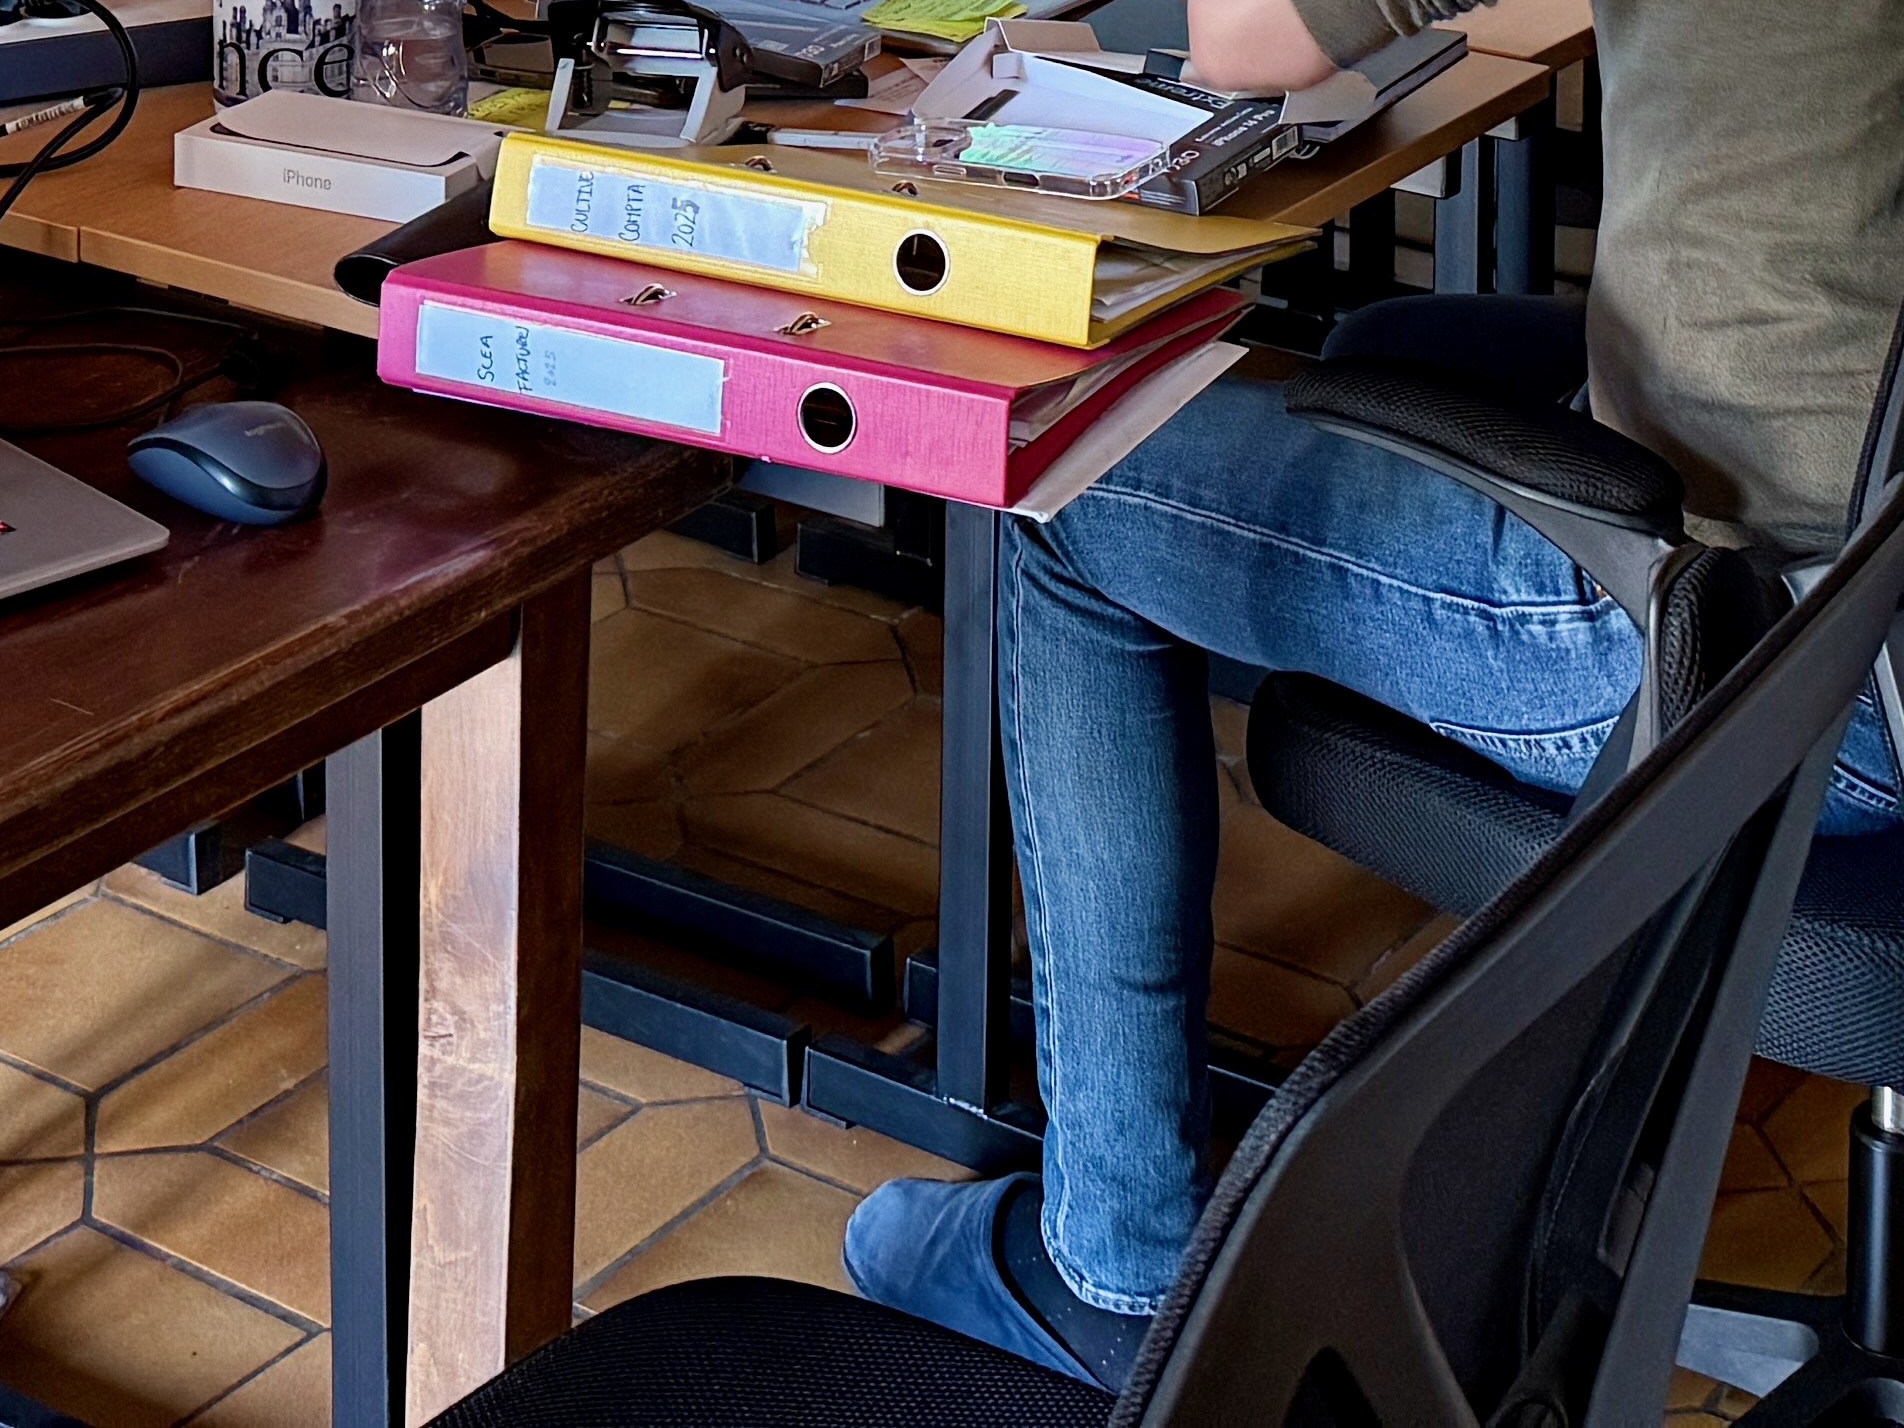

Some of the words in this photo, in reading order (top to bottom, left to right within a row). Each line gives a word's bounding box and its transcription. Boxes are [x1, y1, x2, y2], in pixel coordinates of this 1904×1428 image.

[283, 167, 332, 191] iPhone
[570, 170, 595, 233] CULTIVE
[618, 184, 645, 243] COMPTA
[671, 197, 700, 247] 2025
[477, 335, 495, 383] SCEA
